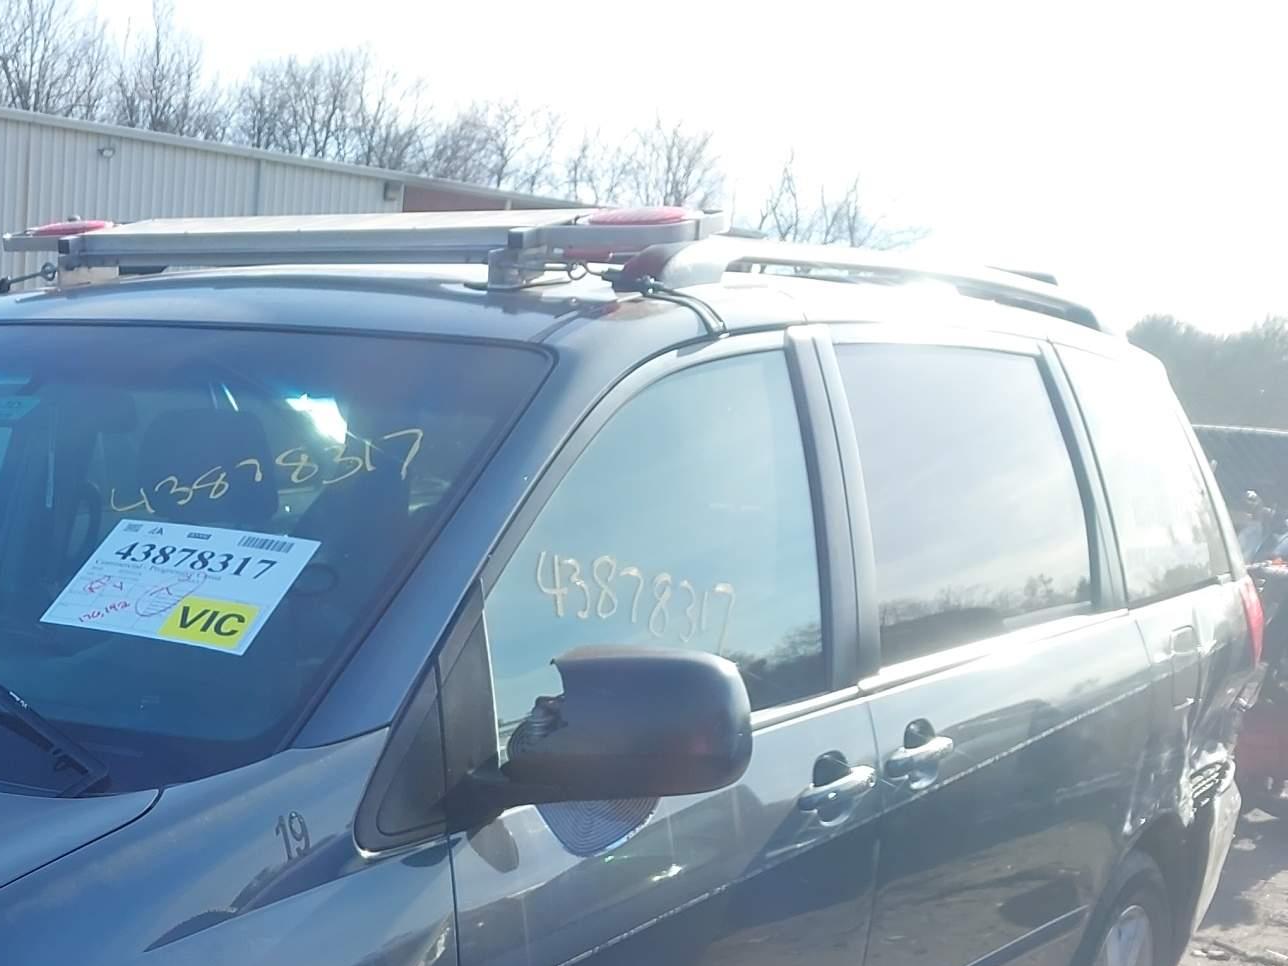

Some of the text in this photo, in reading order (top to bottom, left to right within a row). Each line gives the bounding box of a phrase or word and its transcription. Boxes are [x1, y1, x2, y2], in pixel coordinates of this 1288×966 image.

[111, 429, 423, 514] 43878317
[115, 542, 277, 579] 43878317
[179, 606, 245, 636] VIC
[536, 551, 736, 655] 43878317
[275, 811, 311, 860] 19
